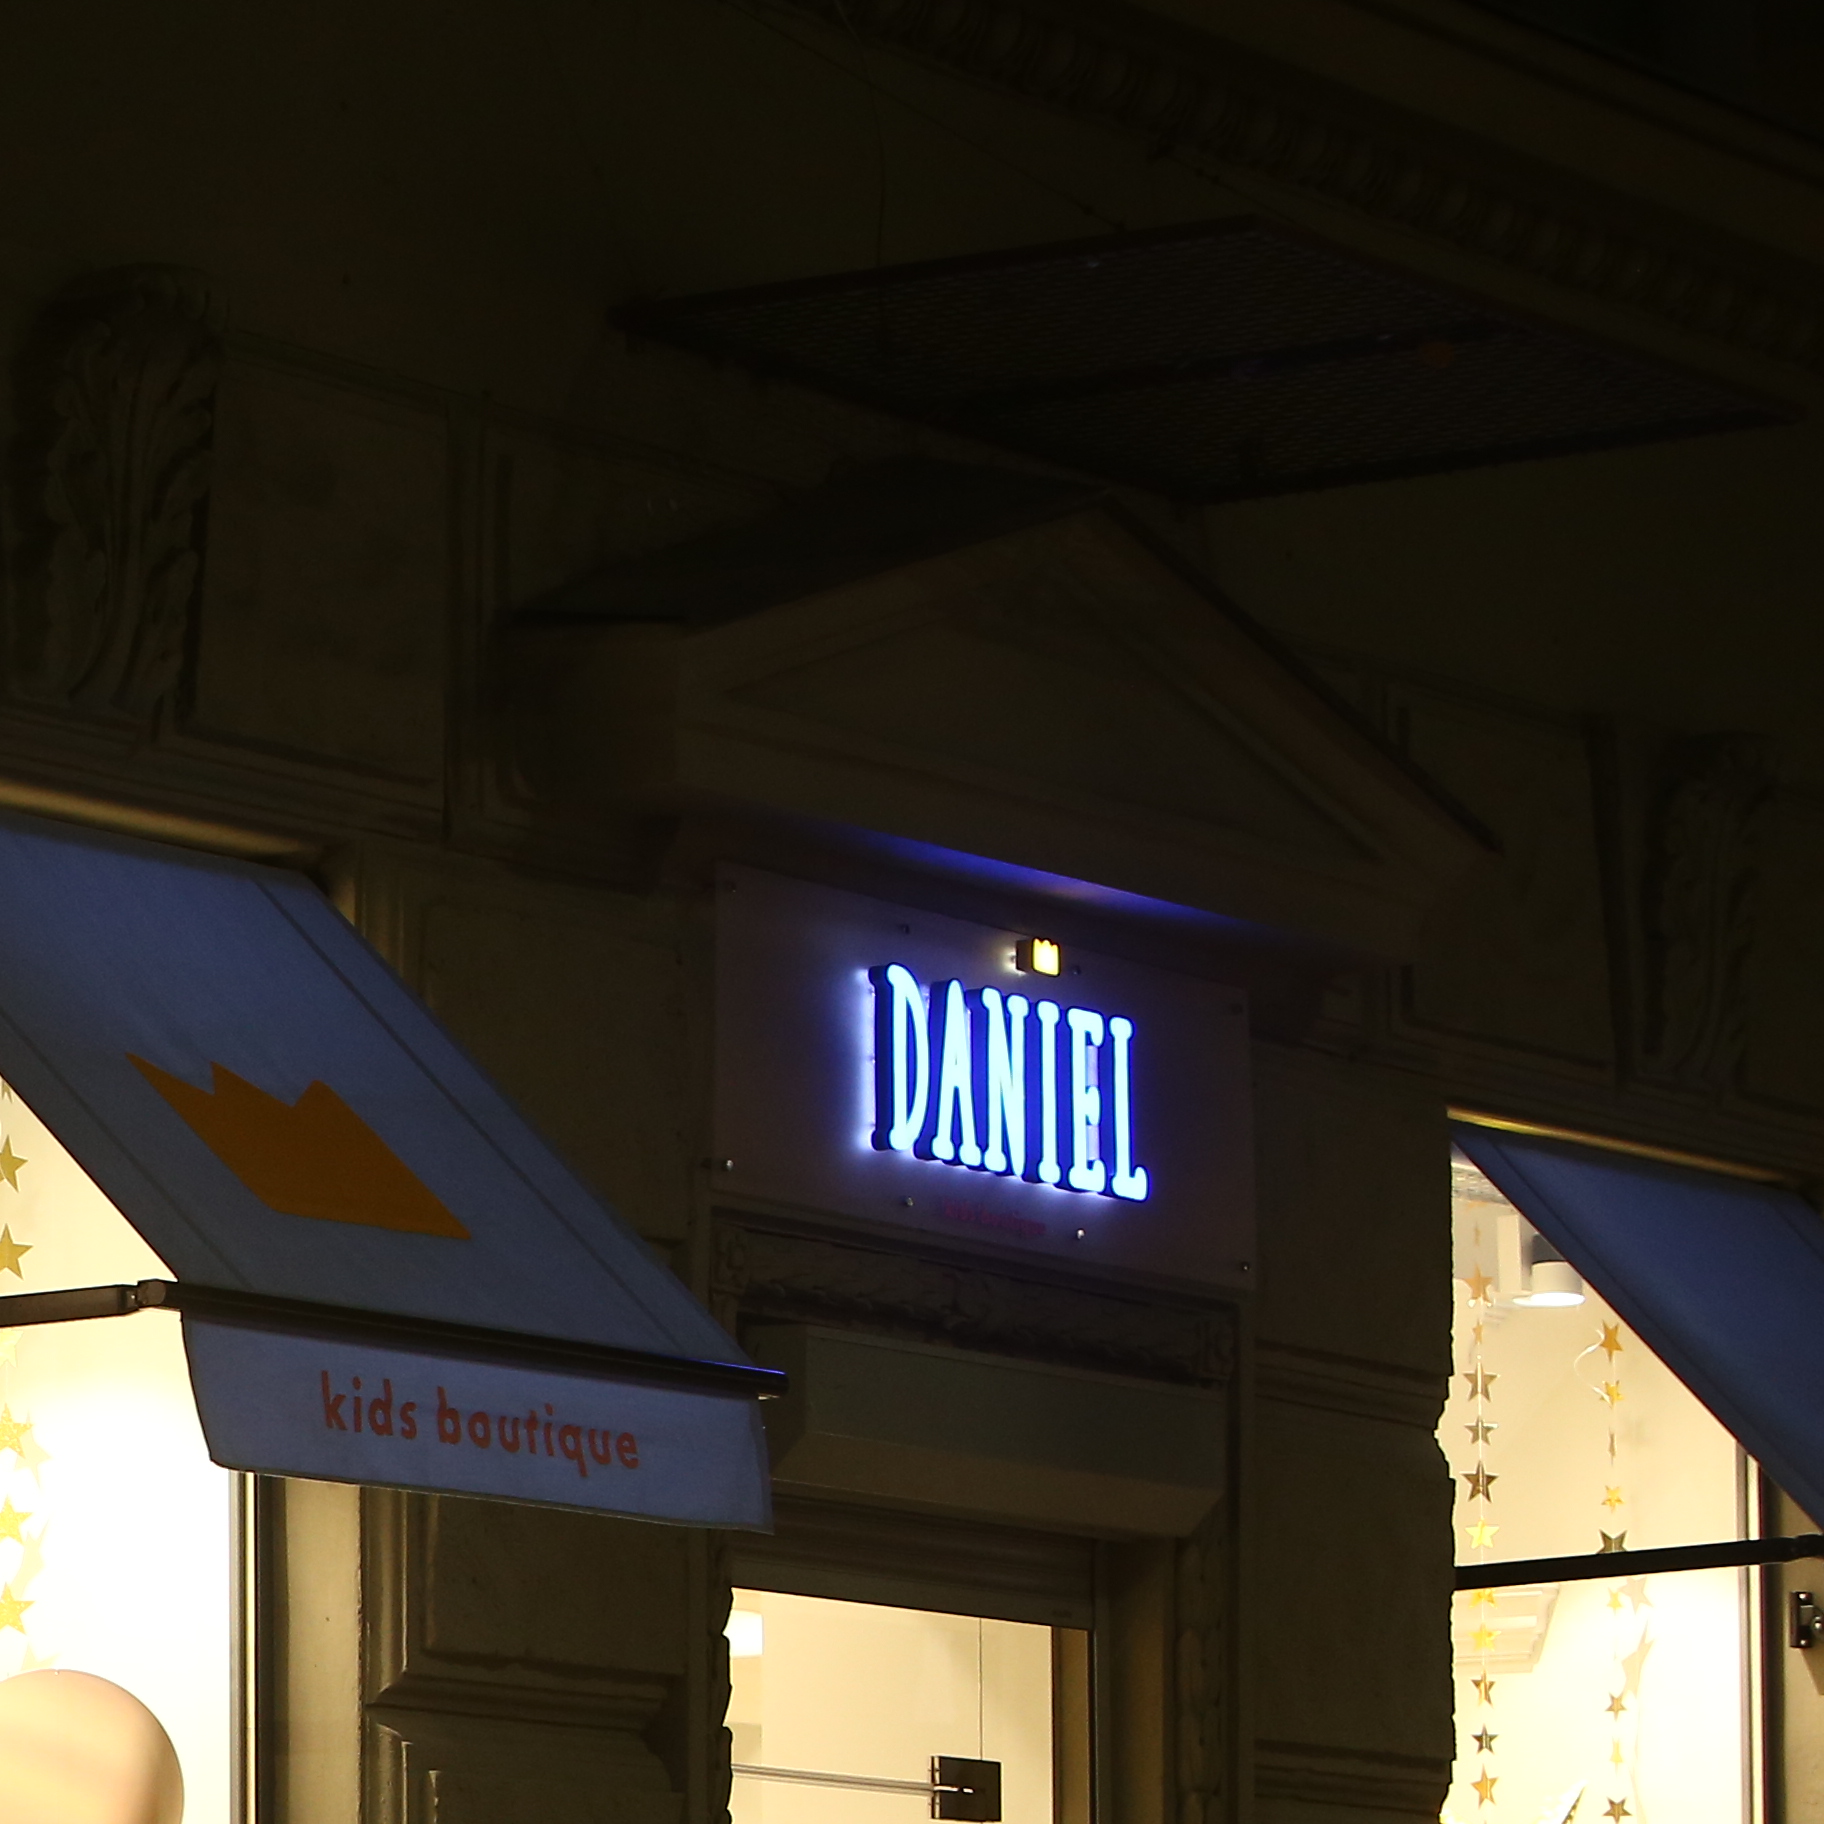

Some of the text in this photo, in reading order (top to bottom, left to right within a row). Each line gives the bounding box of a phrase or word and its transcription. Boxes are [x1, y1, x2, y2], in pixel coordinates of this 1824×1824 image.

[877, 962, 1149, 1202] DANIEL
[321, 1370, 640, 1478] kids boutique
